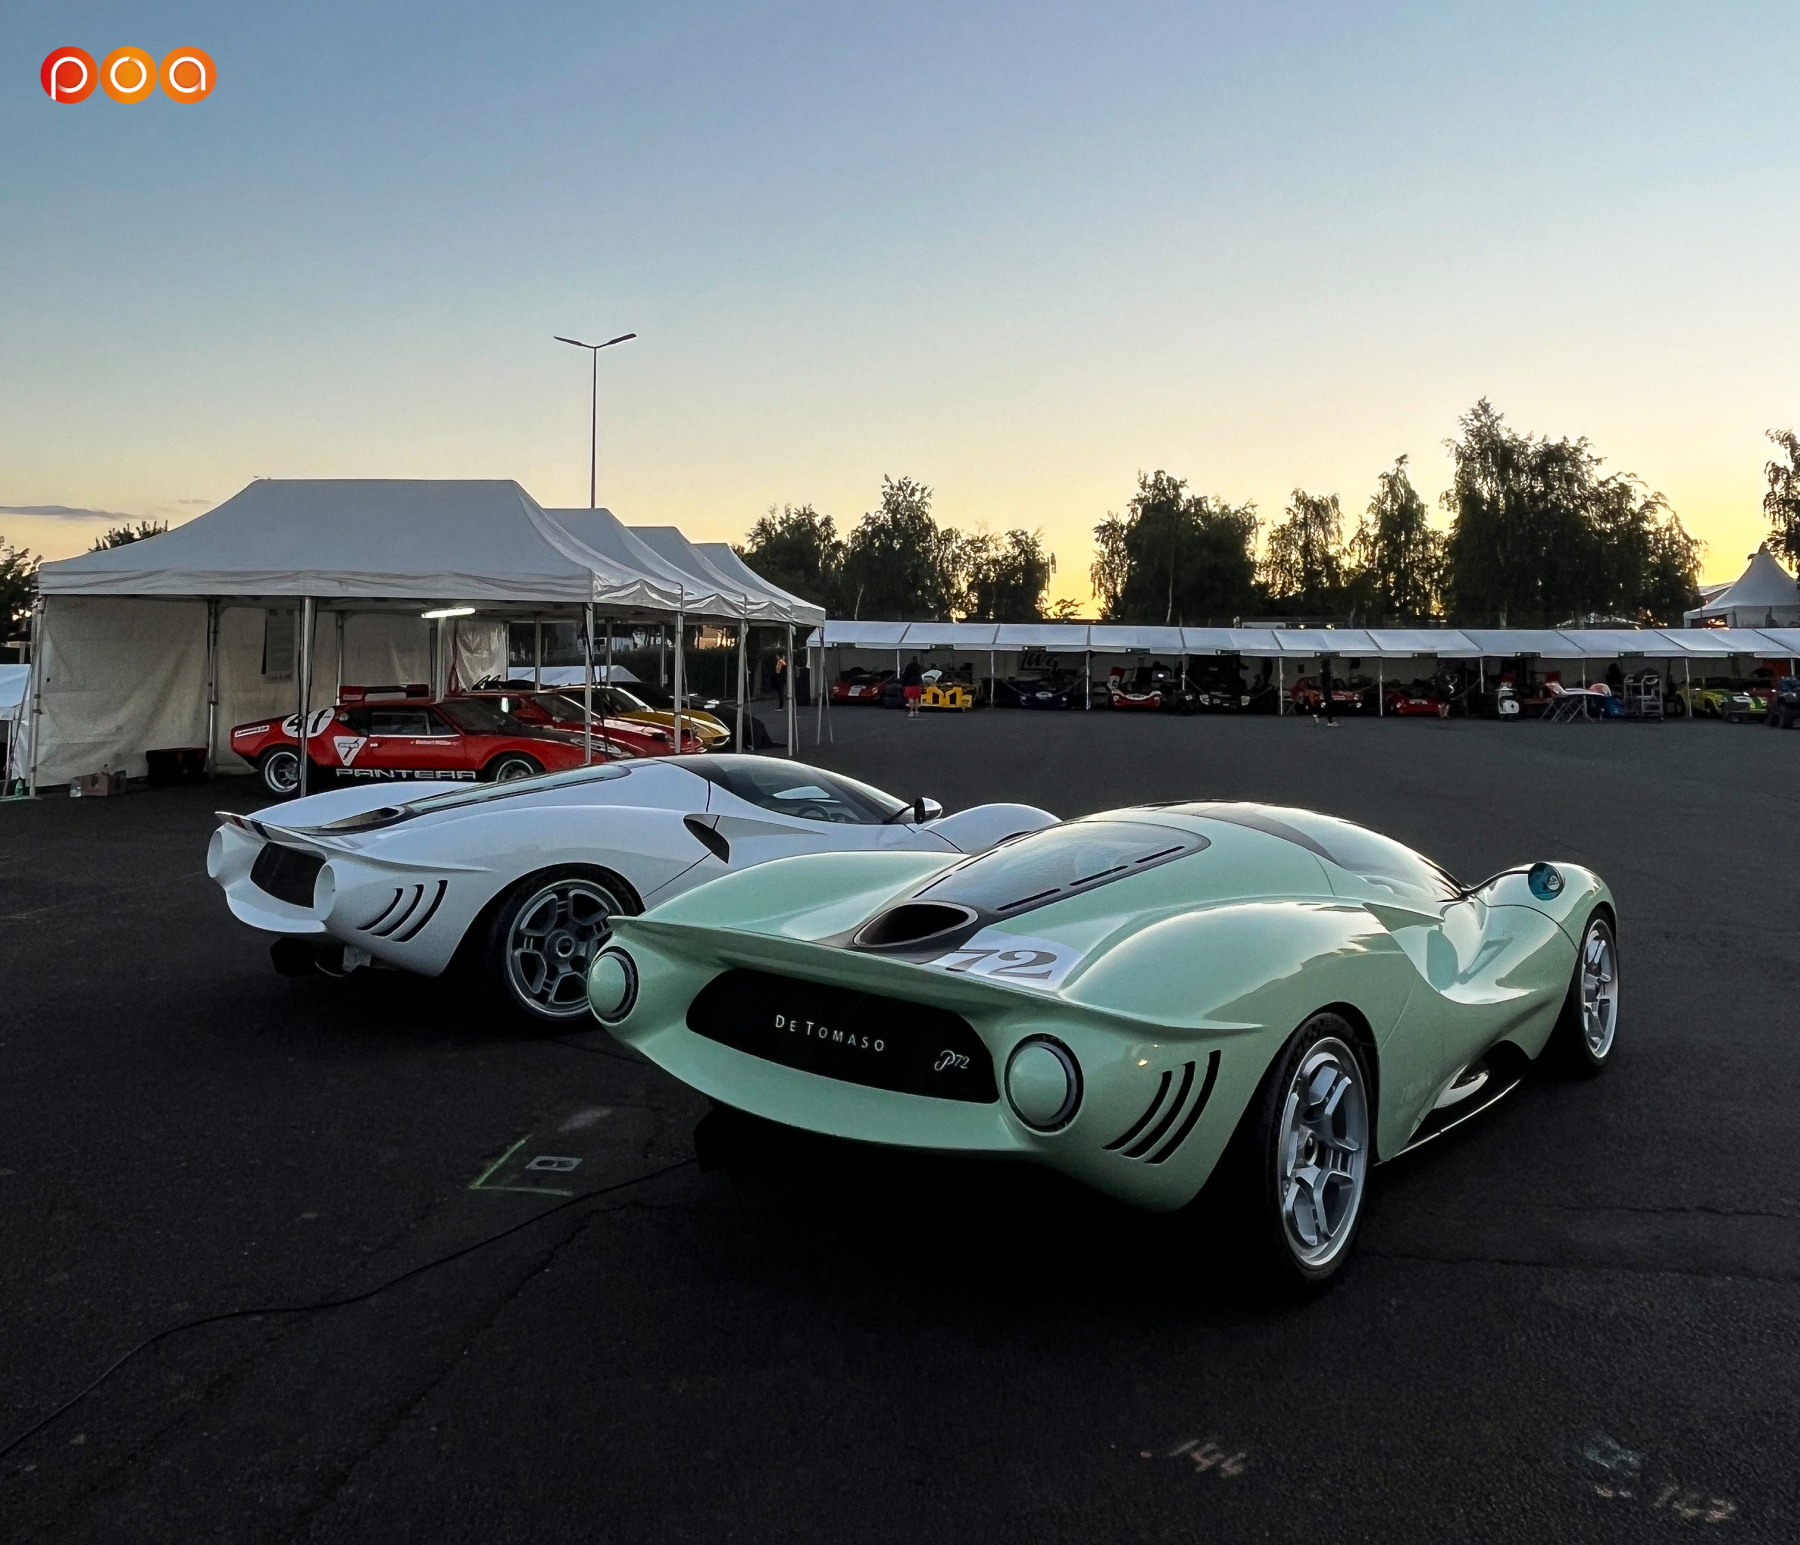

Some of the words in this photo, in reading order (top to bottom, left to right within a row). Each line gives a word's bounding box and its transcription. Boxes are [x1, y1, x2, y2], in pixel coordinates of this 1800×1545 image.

[335, 767, 477, 780] PANTERA
[945, 948, 1058, 980] 72
[934, 1050, 971, 1071] P72
